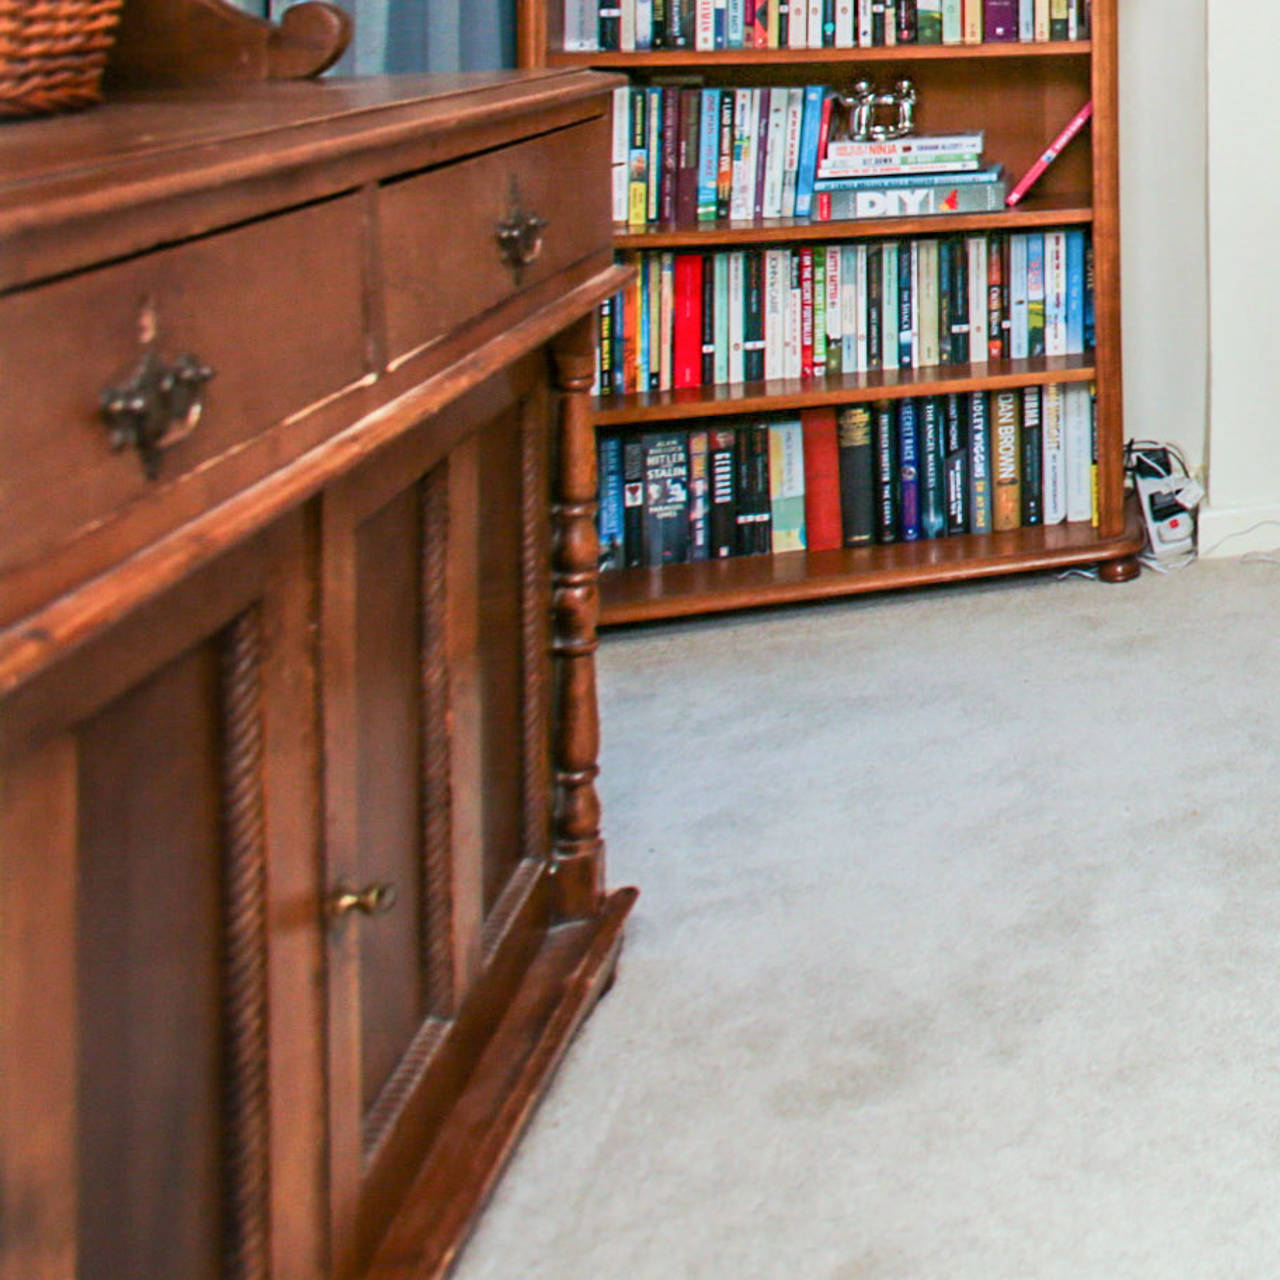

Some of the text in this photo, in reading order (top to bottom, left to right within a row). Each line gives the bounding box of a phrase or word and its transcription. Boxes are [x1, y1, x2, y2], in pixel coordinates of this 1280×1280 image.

[856, 189, 930, 219] DIY
[902, 404, 915, 437] SECRET
[997, 393, 1016, 479] DAN BROWN
[646, 453, 686, 467] HITLER
[973, 431, 985, 478] WIGGINS
[647, 466, 687, 481] STALIN
